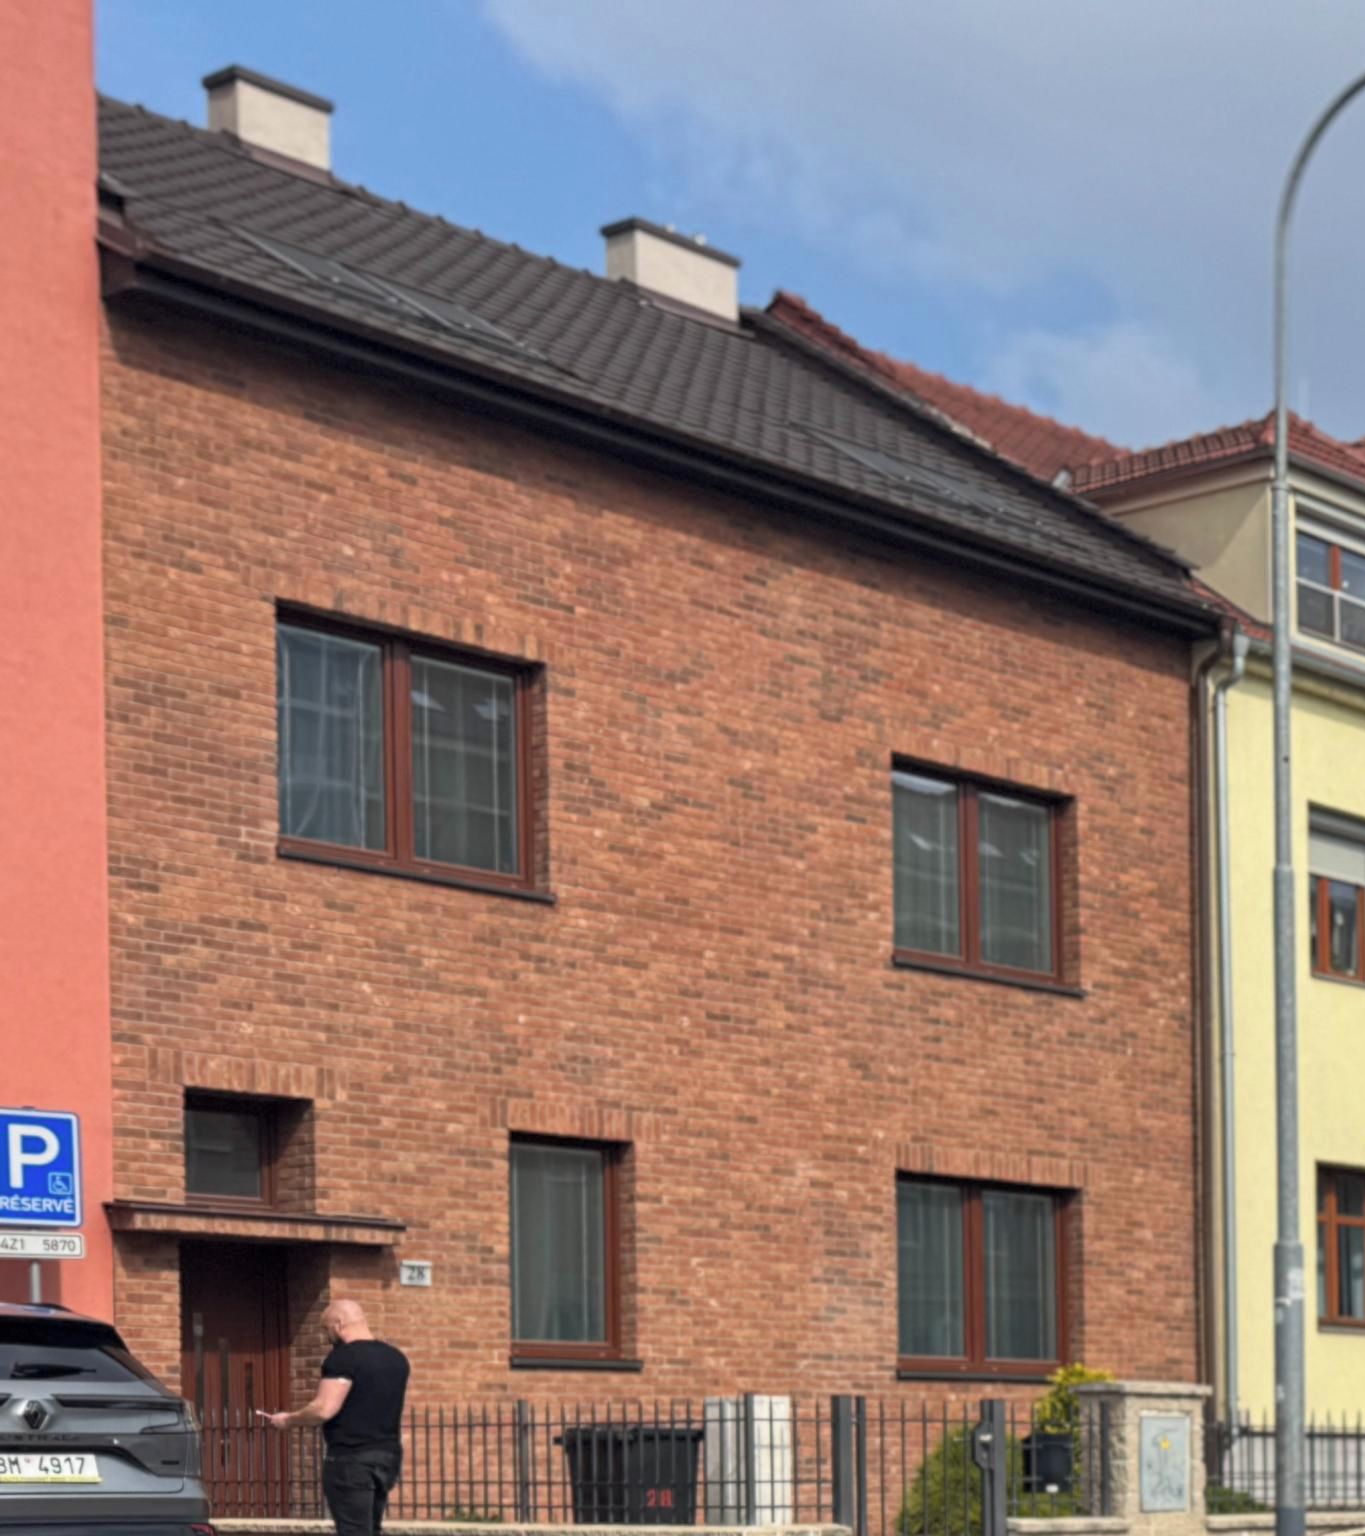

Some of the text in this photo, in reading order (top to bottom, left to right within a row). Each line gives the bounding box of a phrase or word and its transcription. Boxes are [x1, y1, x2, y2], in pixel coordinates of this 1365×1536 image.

[8, 1124, 59, 1189] P
[43, 1239, 76, 1252] 5870
[39, 1456, 85, 1475] 4917
